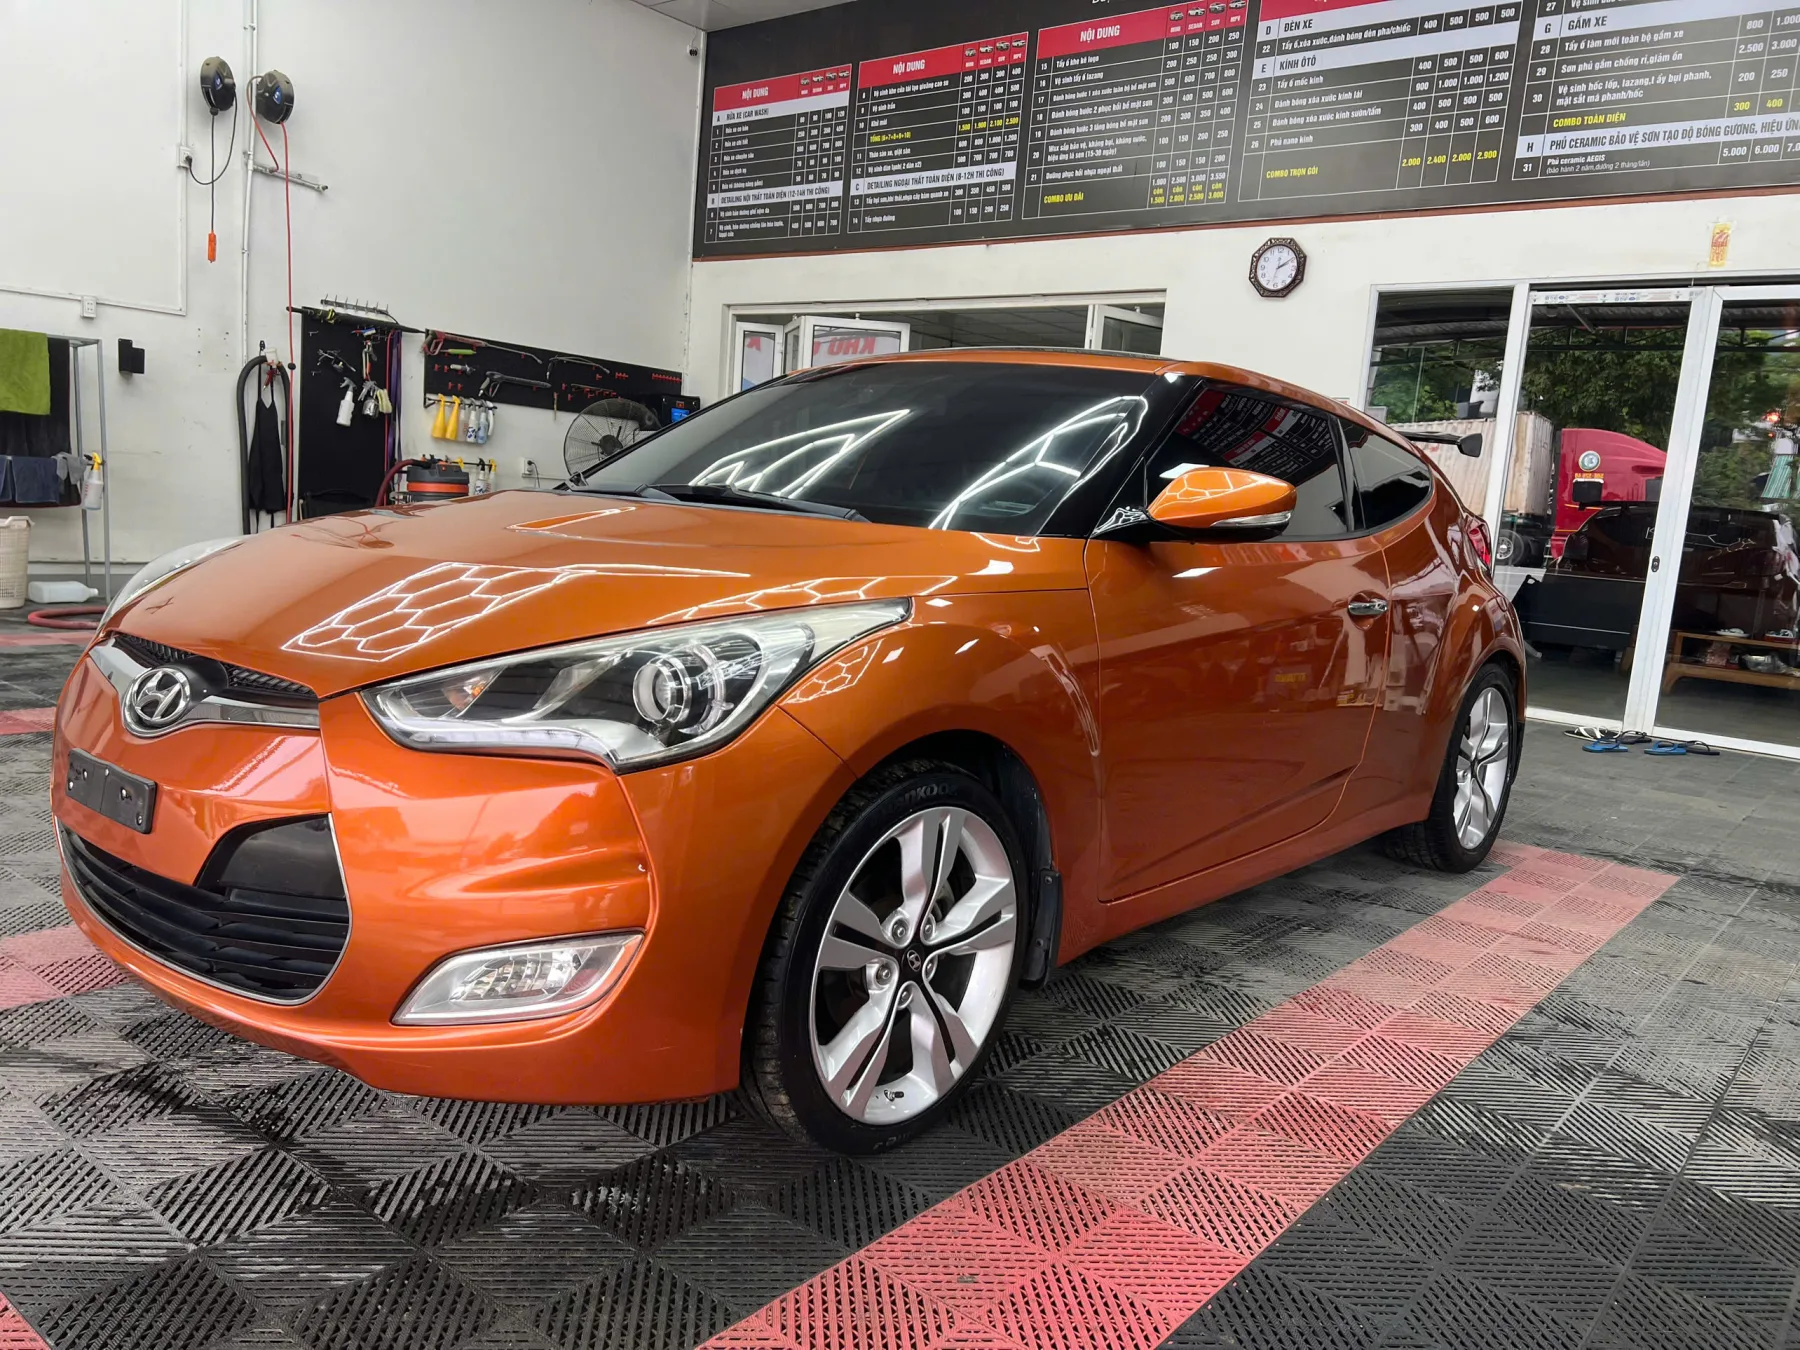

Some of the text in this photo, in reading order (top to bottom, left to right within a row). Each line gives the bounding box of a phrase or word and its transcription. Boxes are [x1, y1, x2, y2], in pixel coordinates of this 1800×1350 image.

[1546, 2, 1556, 11] 27
[1266, 19, 1313, 35] D ĐÈN XE
[1346, 31, 1362, 40] bóng
[1424, 20, 1437, 29] 400
[1450, 16, 1463, 25] 500
[1475, 12, 1489, 21] 500
[1501, 8, 1515, 17] 500
[1545, 23, 1551, 33] G
[1594, 16, 1607, 27] XE
[1080, 25, 1120, 43] NỘI DUNG
[1169, 42, 1179, 50] 100
[1208, 35, 1219, 43] 200
[1228, 32, 1239, 40] 250
[1540, 20, 1763, 54] 28 làm mới toàn bộ xe 800
[1166, 60, 1177, 68] 200
[1186, 57, 1197, 65] 250
[1261, 55, 1316, 73] E KÍNH ÔTÔ
[1536, 39, 1797, 76] 29 Sơn phủ chống 2.500 3.000
[893, 60, 925, 75] NỘI DUNG
[1205, 72, 1215, 80] 700
[1310, 75, 1323, 84] kính
[1419, 61, 1432, 70] 400
[1444, 58, 1457, 67] 500
[1469, 54, 1483, 63] 500
[1495, 51, 1509, 60] 600
[753, 87, 768, 98] DUNG
[1256, 102, 1263, 111] 24
[1416, 82, 1429, 91] 900
[1439, 78, 1457, 88] 1.000
[1464, 75, 1483, 85] 1.000
[1489, 72, 1509, 82] 1.200
[1533, 68, 1788, 102] 30 Vệ sinh hốc bụi phanh, 200 250
[1163, 96, 1173, 104] 300
[1222, 88, 1233, 96] 600
[1254, 93, 1502, 129] 25 400 500 500 500
[1553, 98, 1782, 127] COMBO TOÀN DIỆN 300 400
[1217, 130, 1228, 138] 250
[1283, 137, 1298, 145] nano
[1410, 123, 1423, 132] 300
[1435, 120, 1448, 129] 400
[1460, 118, 1474, 126] 500
[1486, 115, 1499, 124] 600
[1527, 142, 1534, 152] H
[1550, 136, 1566, 150] PHỦ
[1569, 137, 1606, 149] CERAMIC
[1609, 133, 1625, 145] BẢO
[1629, 131, 1639, 145] VỆ
[1642, 130, 1660, 143] SƠN
[1662, 130, 1679, 143] TẠO
[1681, 126, 1693, 141] ĐỘ
[1696, 125, 1721, 138] BÓNG
[1761, 119, 1783, 134] HIỆU
[1785, 117, 1800, 131] ỨN
[1266, 170, 1288, 178] COMBO
[1308, 166, 1318, 176] GÓI
[1402, 158, 1420, 166] 2.000
[1427, 155, 1446, 164] 2.400
[1477, 150, 1497, 159] 2.900
[1523, 164, 1532, 172] 31
[1560, 156, 1585, 164] ceramic
[1723, 147, 1746, 157] 5.000
[1755, 144, 1779, 154] 6.000
[867, 179, 893, 190] DETAILING
[976, 170, 985, 178] THI
[1210, 172, 1225, 180] 3.550
[1044, 195, 1064, 203] COMBO
